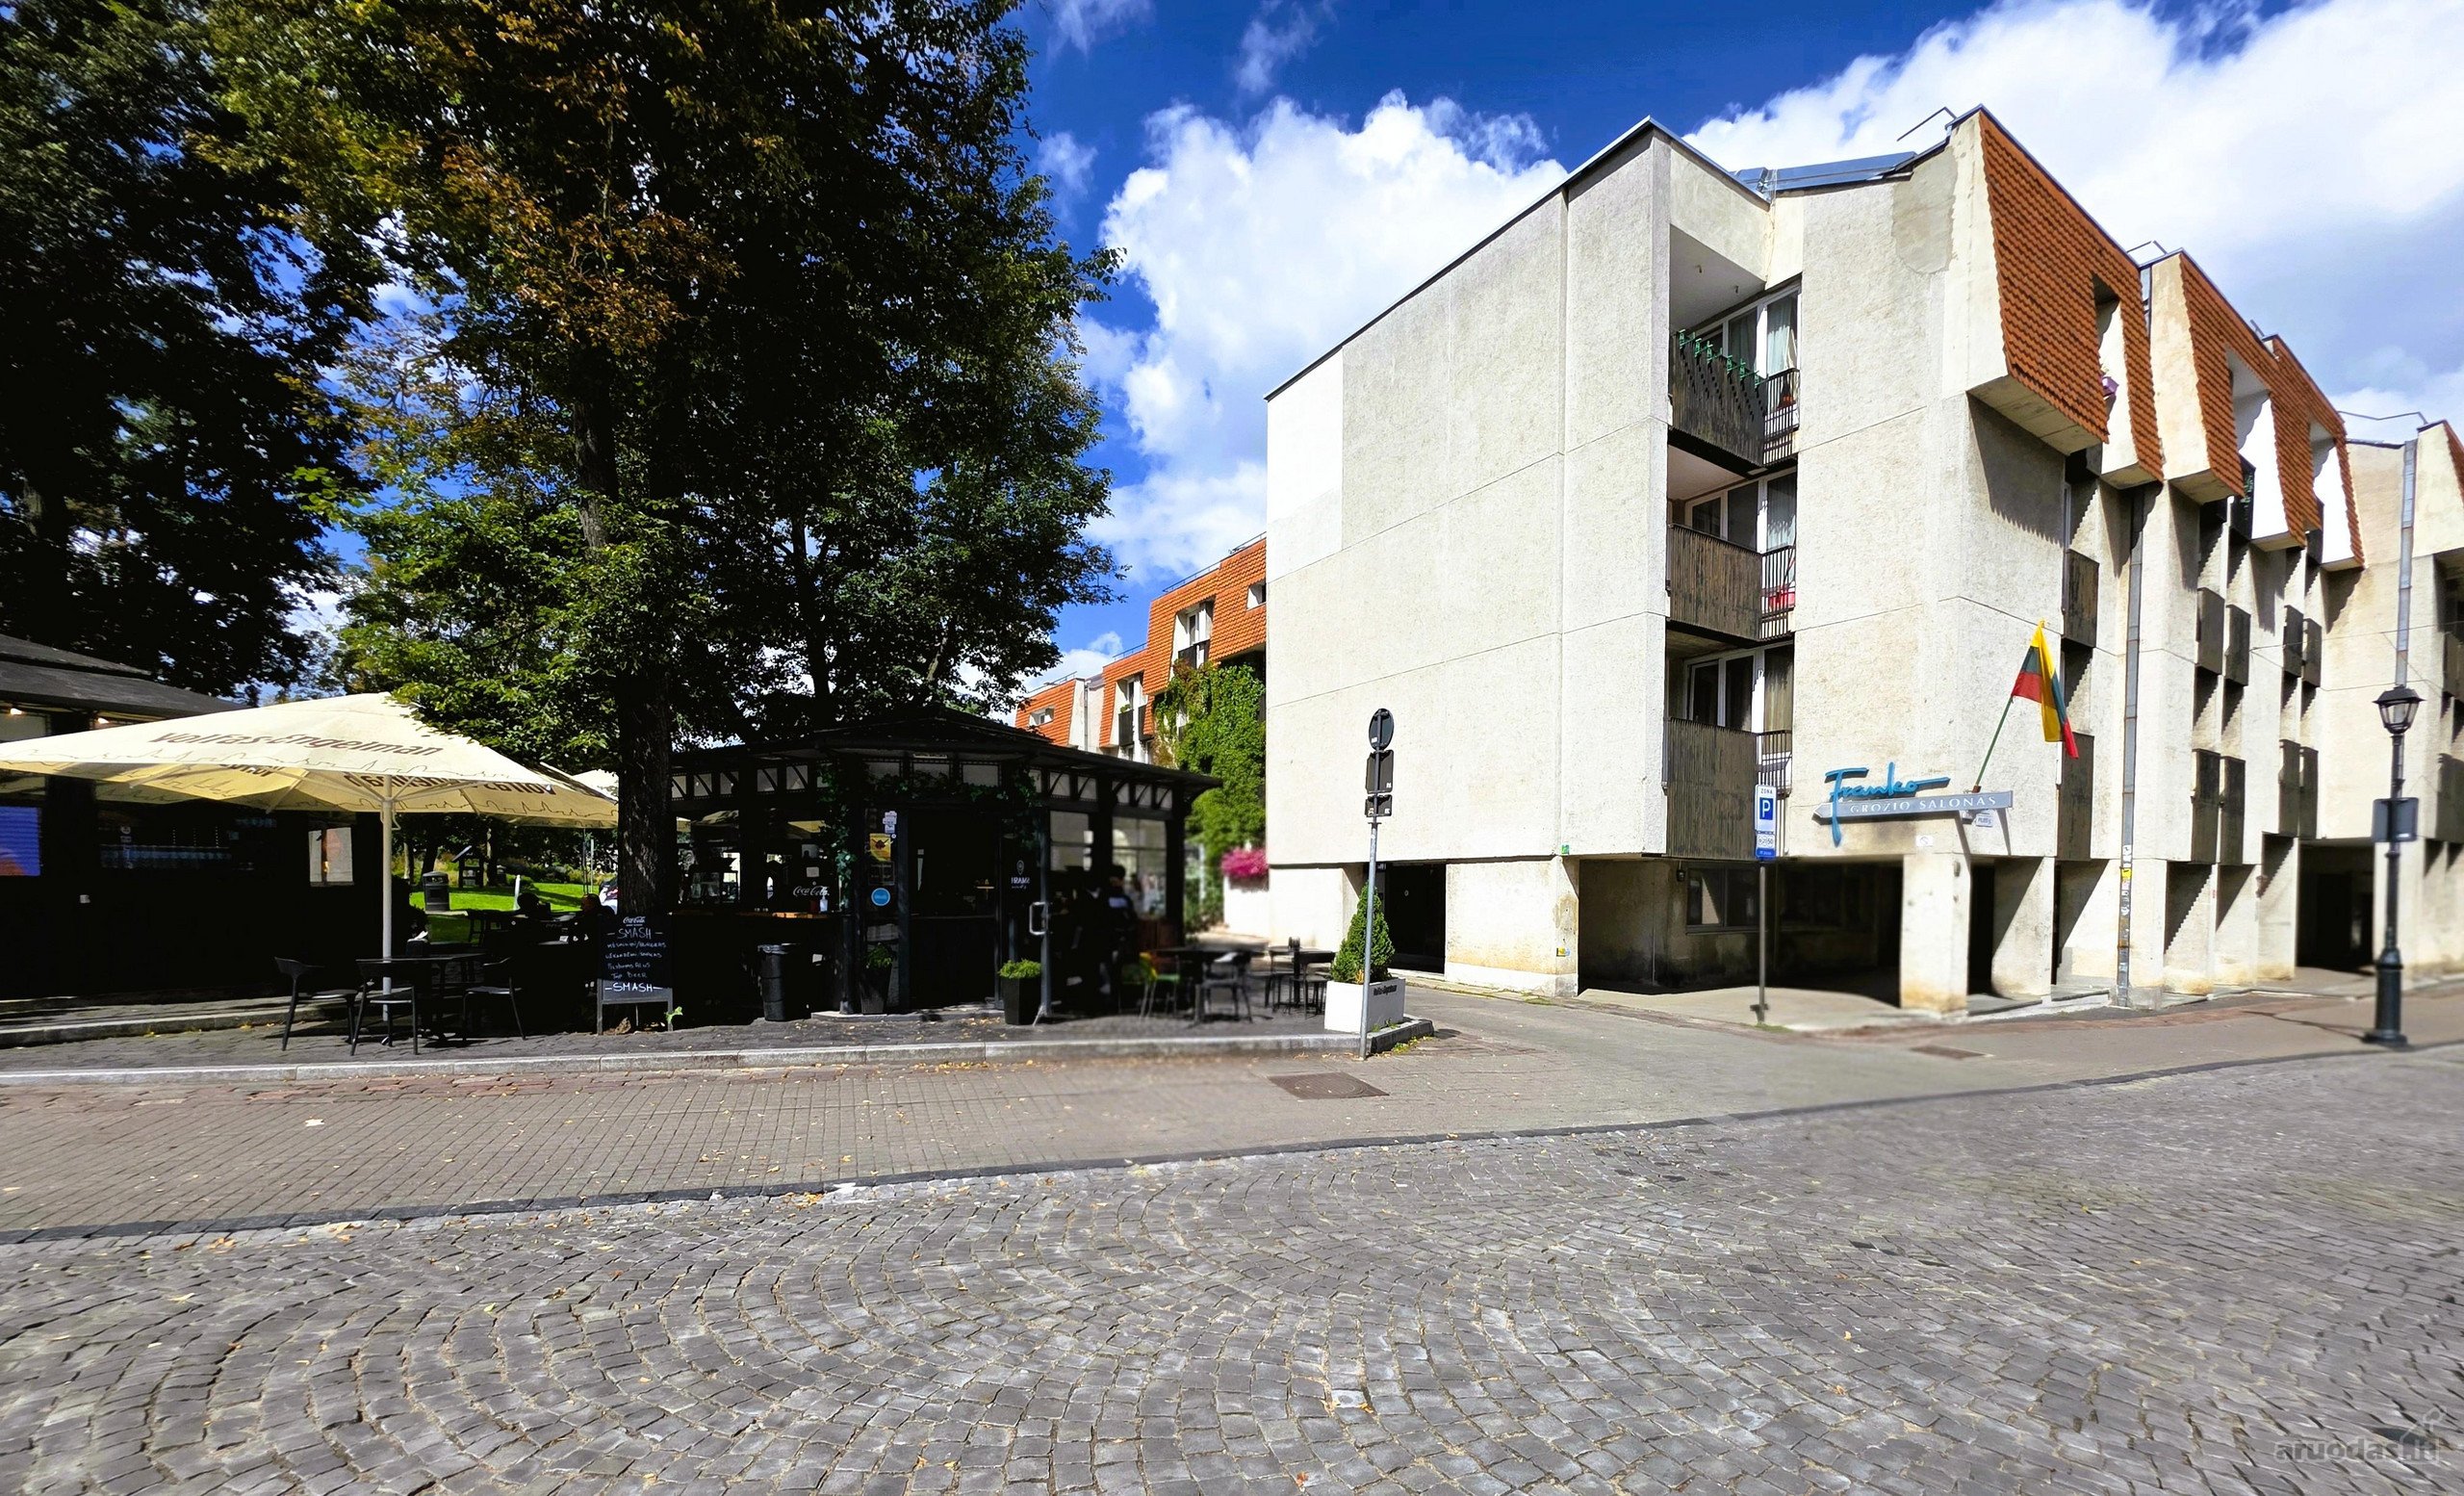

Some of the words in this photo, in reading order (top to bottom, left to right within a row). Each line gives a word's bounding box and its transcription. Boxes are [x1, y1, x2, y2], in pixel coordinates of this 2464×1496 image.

[1761, 799, 1771, 818] P
[1824, 761, 1952, 848] Franko
[1919, 795, 1996, 810] SALONAS
[617, 927, 652, 940] SMASH
[612, 982, 654, 993] SMASH
